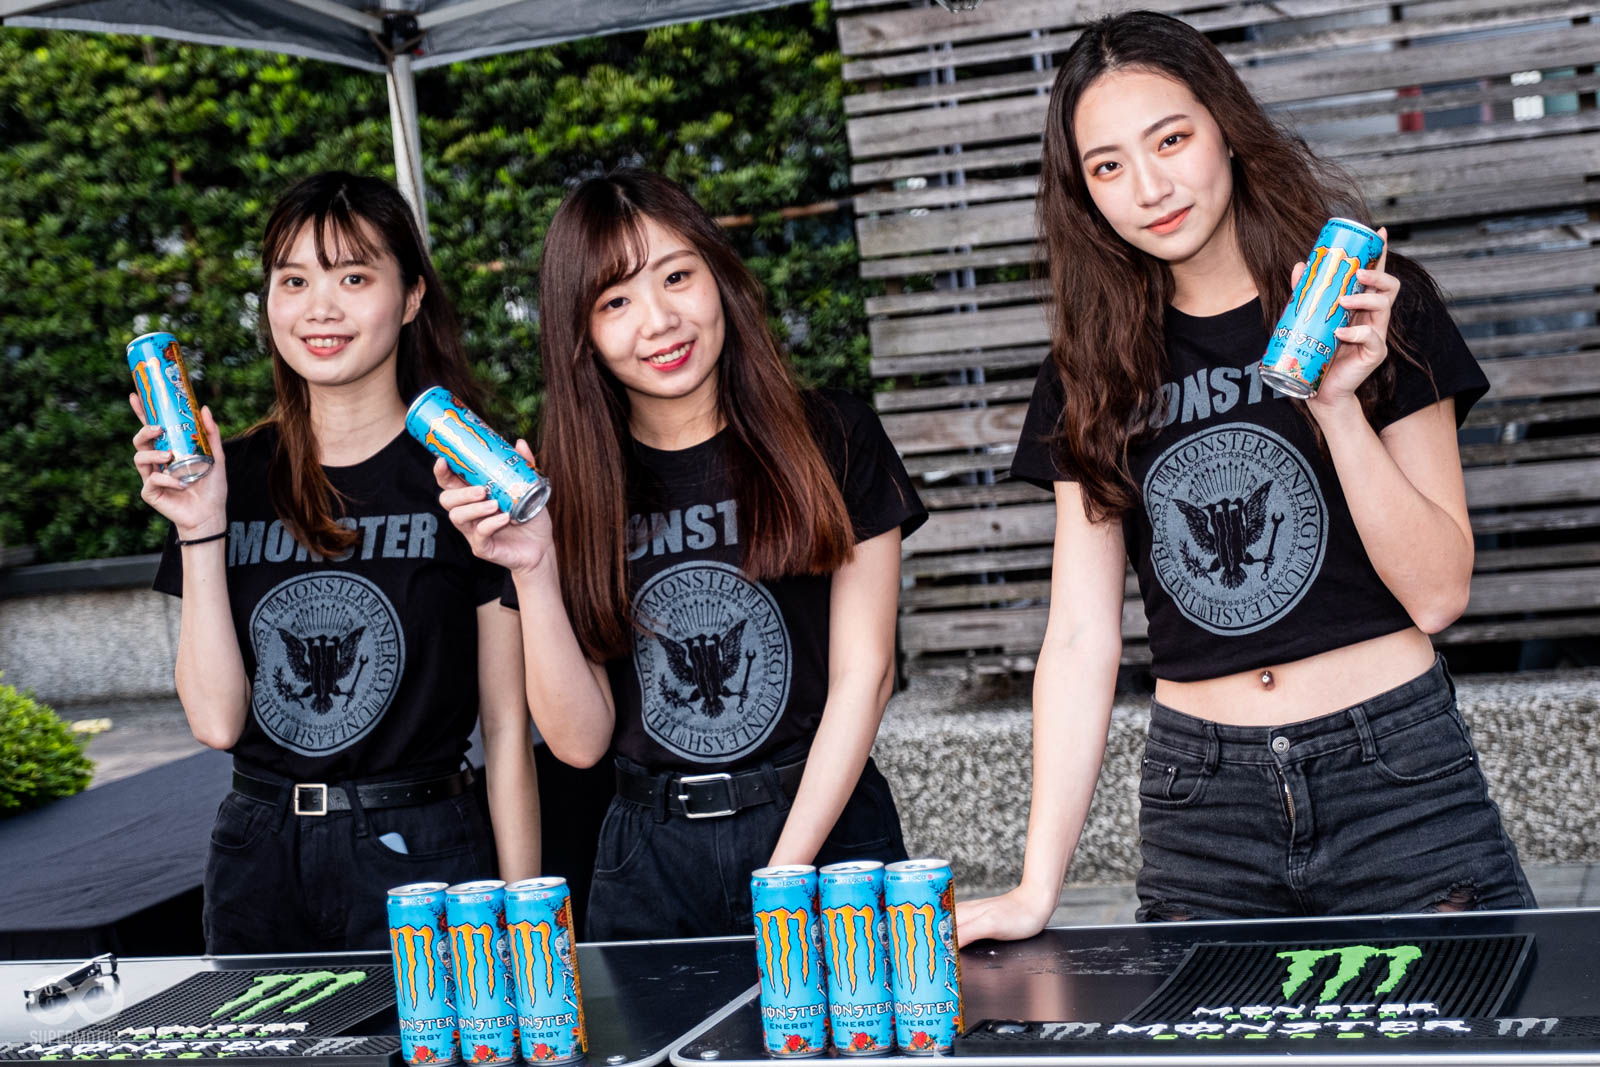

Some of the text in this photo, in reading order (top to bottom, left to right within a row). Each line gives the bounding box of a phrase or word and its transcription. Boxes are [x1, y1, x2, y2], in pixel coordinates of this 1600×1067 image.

[1274, 342, 1316, 360] ENRGY
[1149, 360, 1287, 428] ONST
[1167, 432, 1319, 557] MONSTER ENERGY
[627, 499, 738, 560] ONST
[1164, 569, 1304, 625] THE UNLEASH
[277, 578, 397, 700] MONSTER ENERGY
[645, 571, 785, 693] MONSTER ENERGY
[293, 705, 375, 747] UNLEASH
[687, 703, 770, 753] UNLEASH
[895, 1000, 956, 1018] ONSTER
[399, 1015, 456, 1033] ONSTER
[459, 1014, 517, 1032] ONSTER
[518, 1012, 575, 1031] ONSTER
[769, 1021, 815, 1031] ENERGY
[836, 1018, 882, 1028] ENERGY
[898, 1018, 942, 1028] ENERGY
[402, 1032, 442, 1042] ENERGY
[462, 1032, 502, 1042] ENERGY
[522, 1030, 561, 1040] ENERGY
